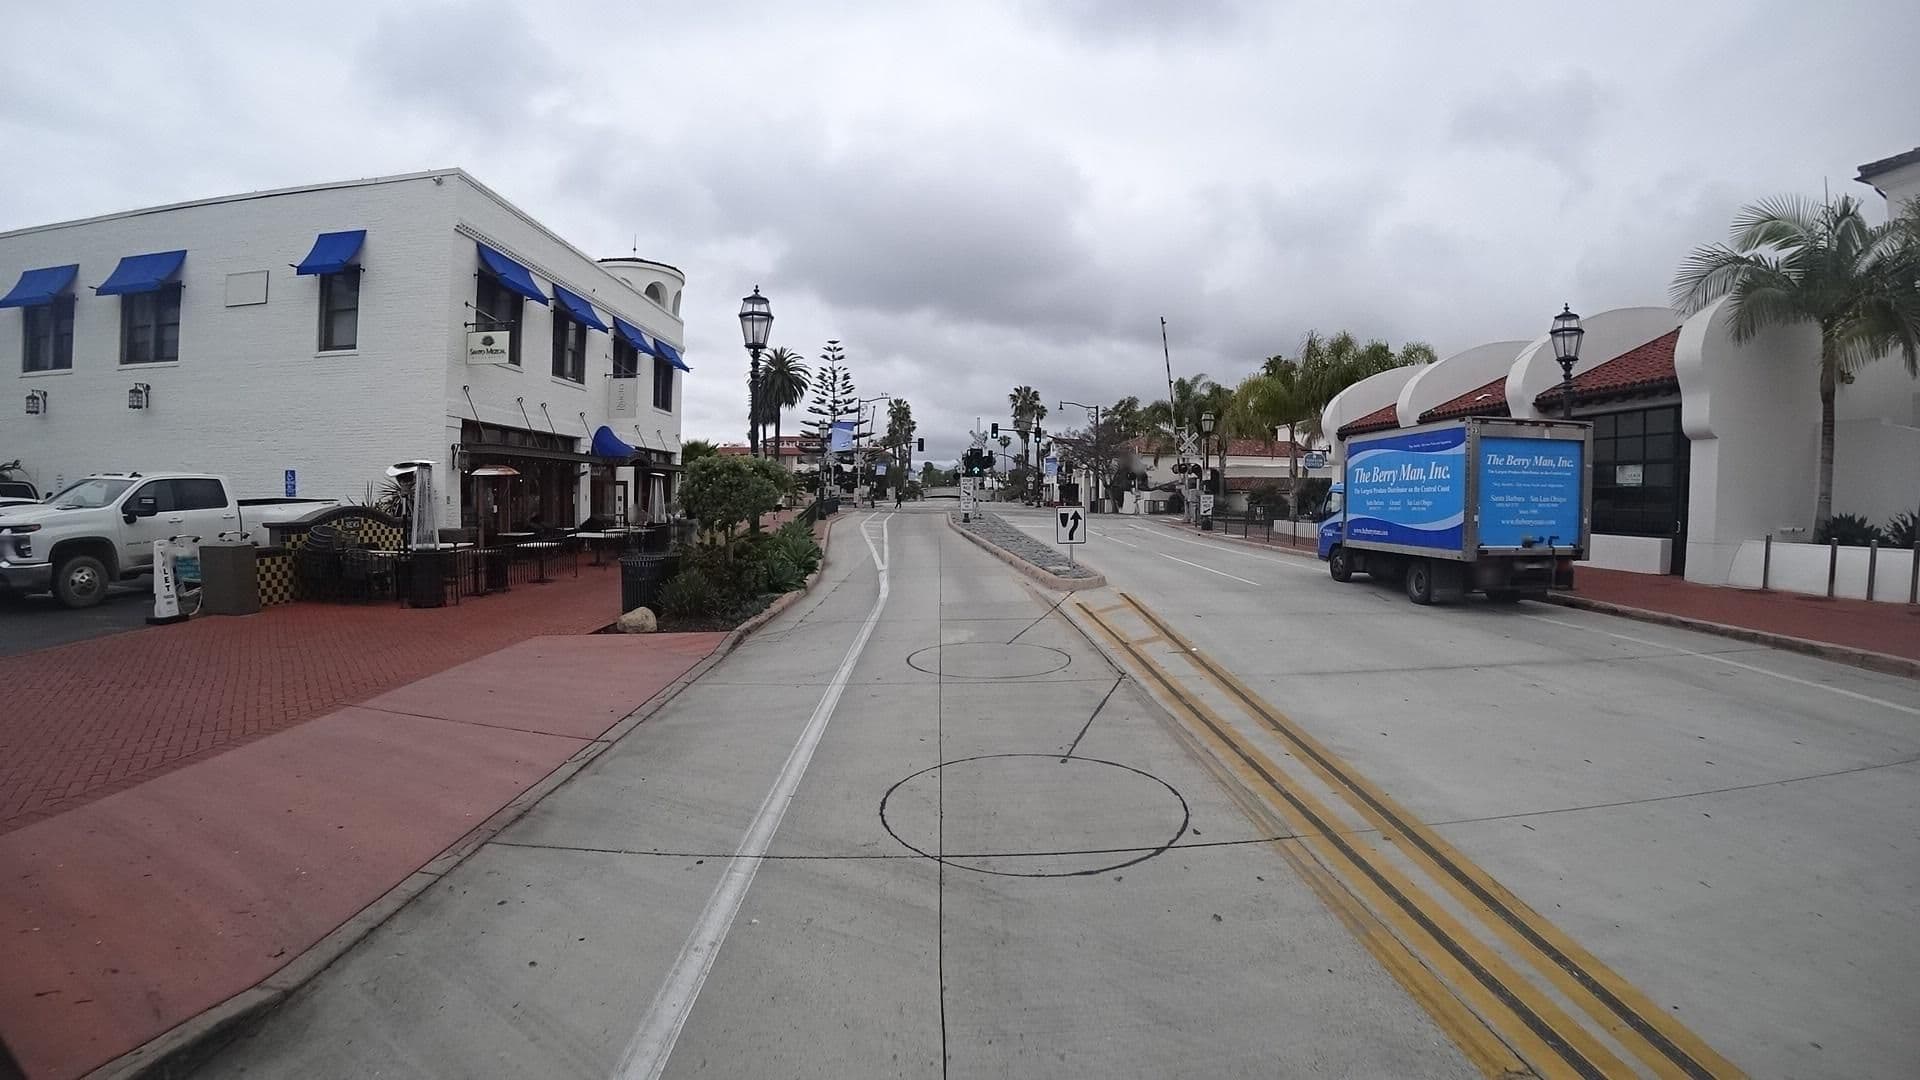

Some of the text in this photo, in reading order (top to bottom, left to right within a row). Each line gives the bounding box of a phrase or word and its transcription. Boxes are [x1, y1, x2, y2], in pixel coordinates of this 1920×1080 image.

[1487, 454, 1574, 469] The Berry Man, Inc.
[1354, 461, 1450, 486] The Berry Man, Inc.
[1421, 485, 1436, 493] Ctral
